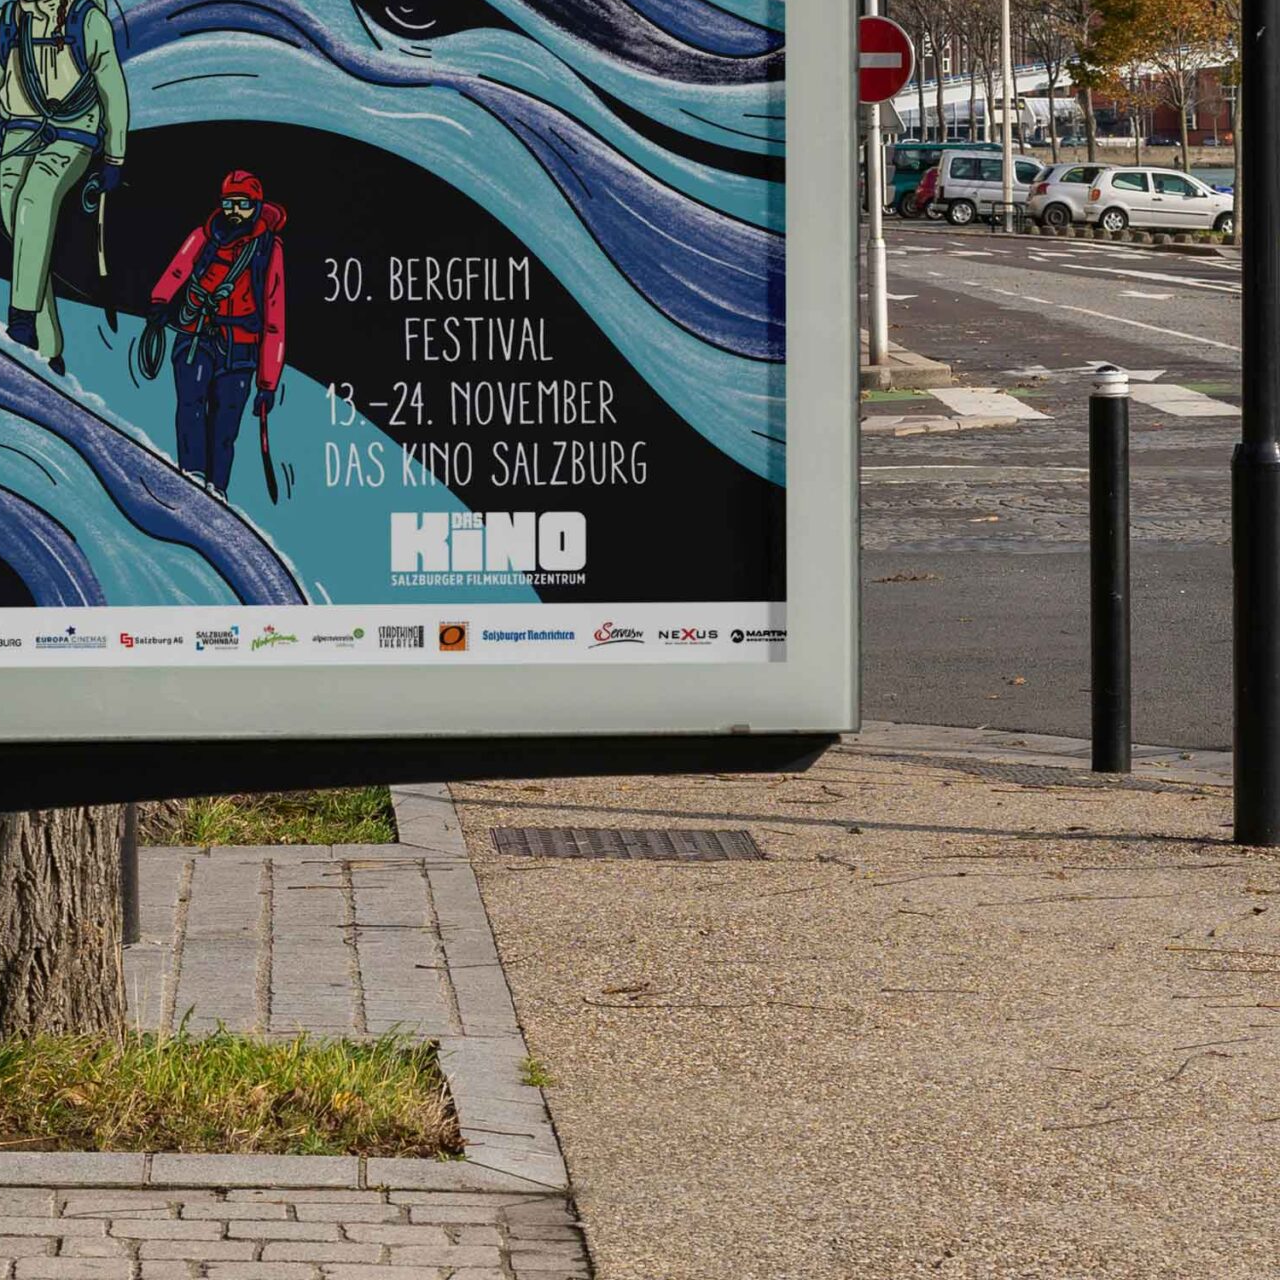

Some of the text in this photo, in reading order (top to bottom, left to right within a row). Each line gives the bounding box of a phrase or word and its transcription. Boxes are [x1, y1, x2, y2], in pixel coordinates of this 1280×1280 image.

[324, 256, 530, 302] 30. BERGFILM
[404, 316, 553, 362] FESTIVAL
[451, 380, 617, 425] NOVEMBER
[324, 440, 647, 487] DAS KINO SALZBURG
[451, 511, 483, 529] DAS
[391, 572, 586, 586] SALZBURGER FILMKULTURZENTRUM
[35, 636, 69, 644] EUROPA
[135, 636, 172, 645] Salzburg
[482, 630, 526, 642] Salzburger
[527, 629, 575, 641] Nachrichten
[658, 628, 719, 641] NEXUS
